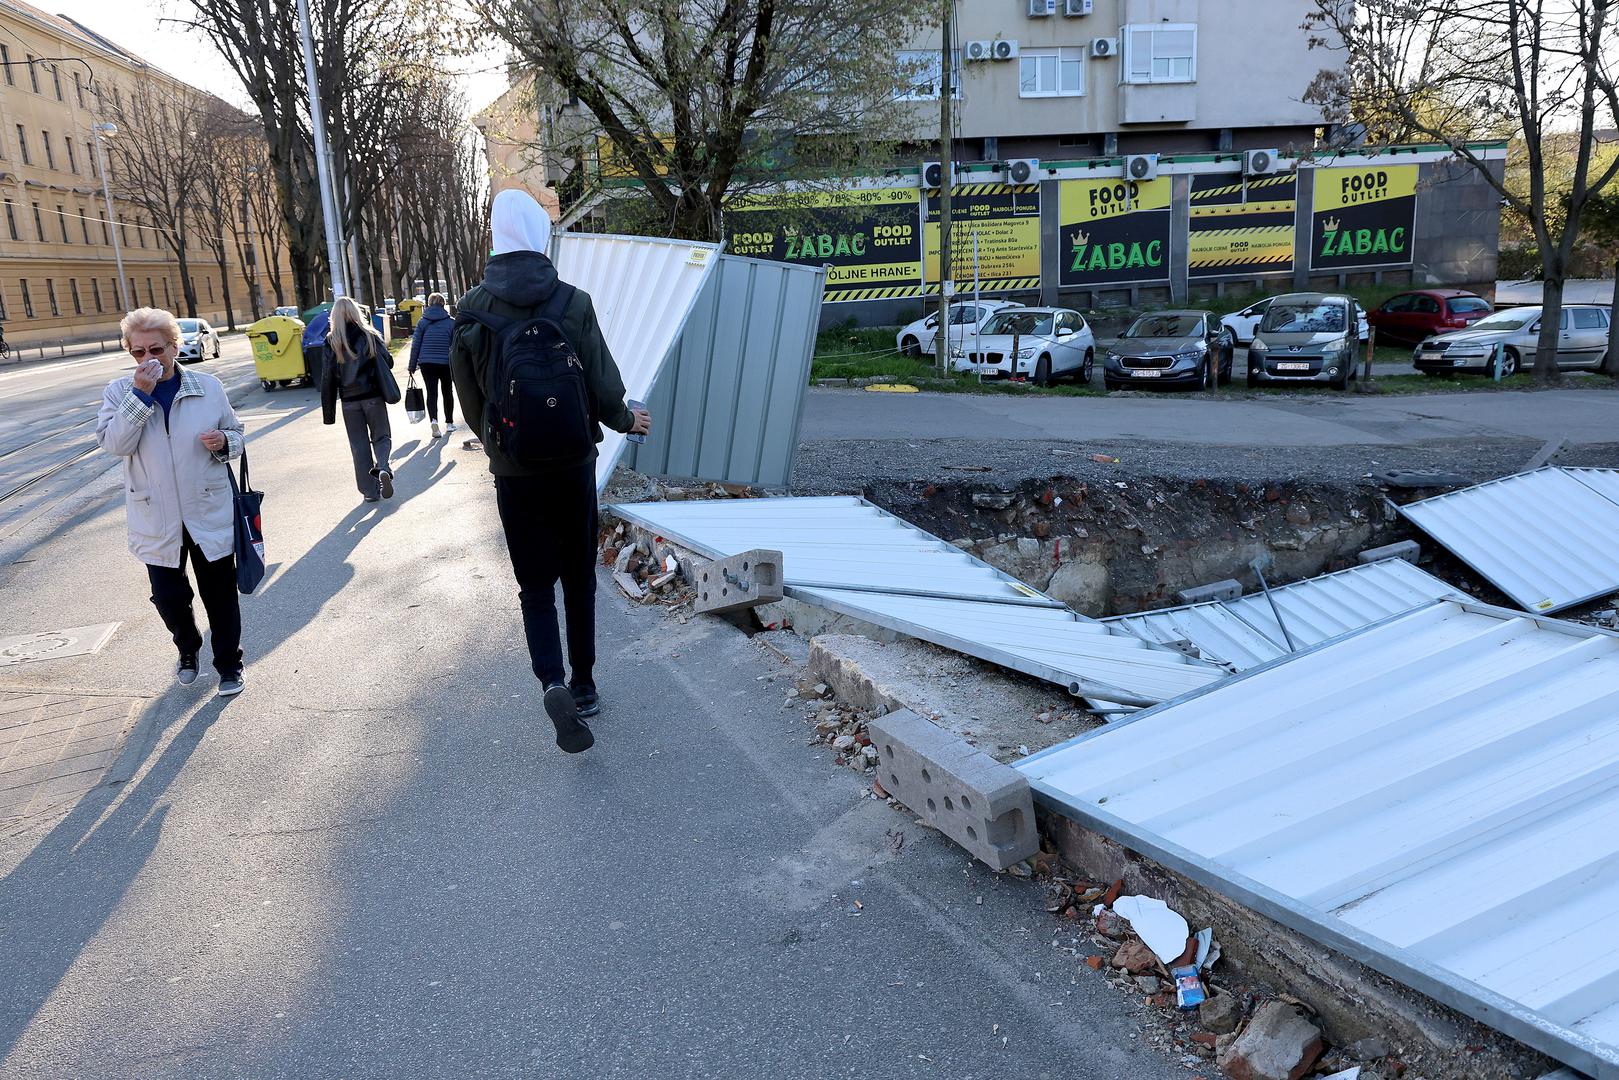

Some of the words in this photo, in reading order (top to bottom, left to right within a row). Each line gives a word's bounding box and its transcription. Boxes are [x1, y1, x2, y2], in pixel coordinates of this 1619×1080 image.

[1341, 171, 1388, 194] FOOD
[856, 192, 881, 203] -80%
[887, 190, 912, 201] -90%
[1089, 182, 1139, 206] FOOD
[1341, 187, 1388, 204] OUTLET
[873, 224, 912, 237] FOOD
[732, 232, 774, 245] FOOD
[874, 236, 912, 247] OUTLET
[733, 244, 774, 255] OUTLET
[826, 266, 867, 281] OLJNE
[870, 265, 911, 279] HRANE
